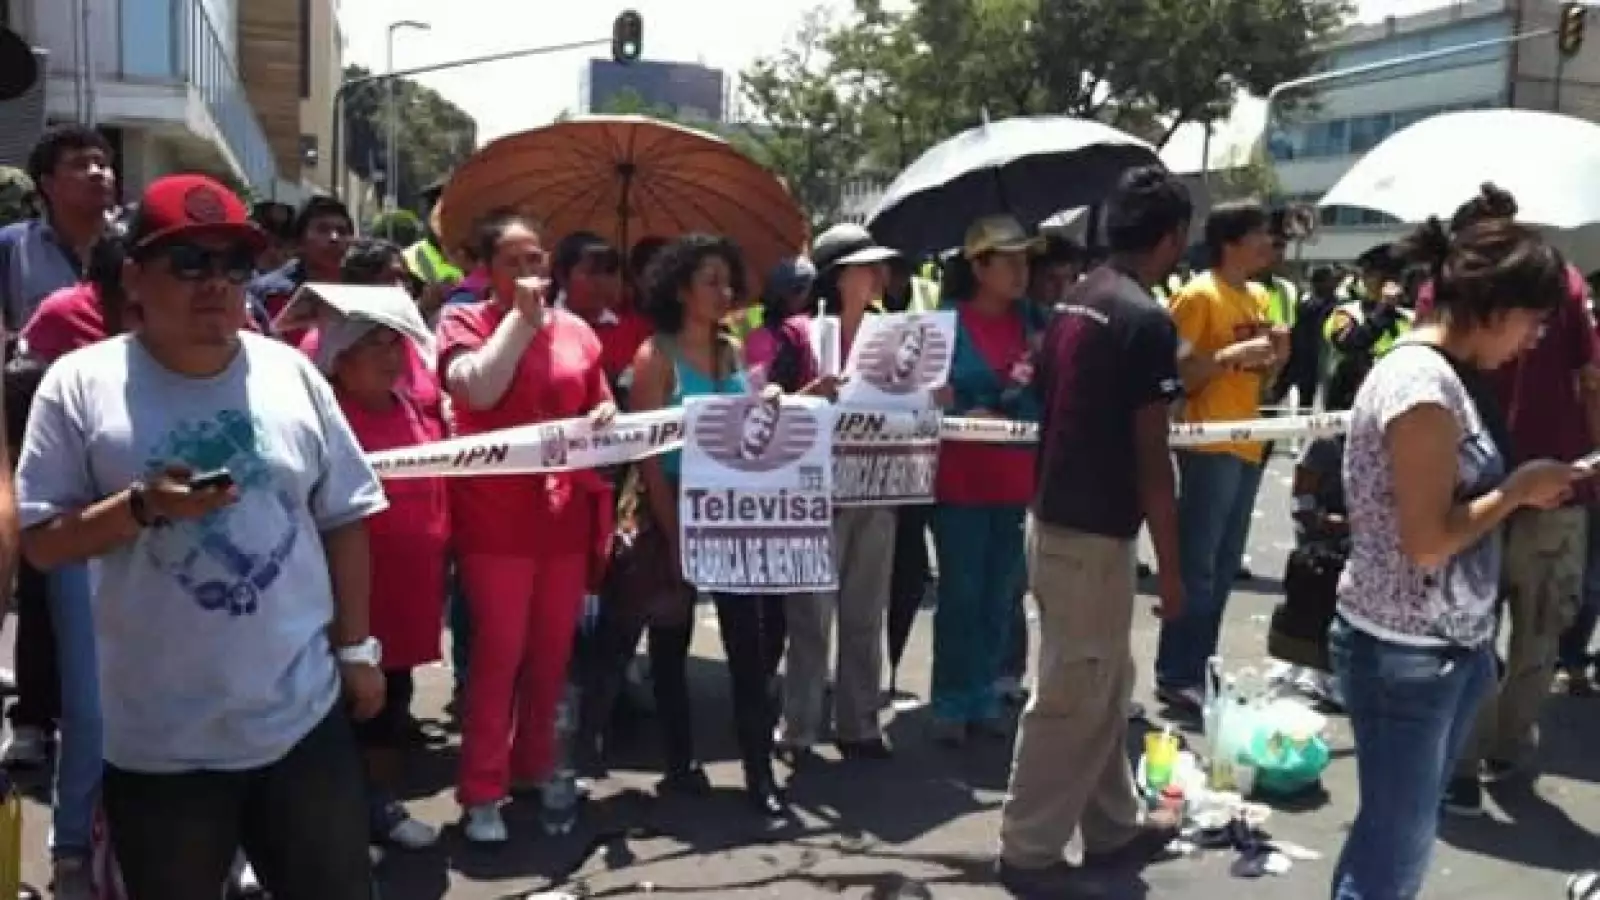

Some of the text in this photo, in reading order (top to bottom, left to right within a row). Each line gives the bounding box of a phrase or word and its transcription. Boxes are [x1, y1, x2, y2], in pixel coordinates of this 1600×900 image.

[835, 412, 886, 431] IPN
[452, 443, 508, 467] IPN
[685, 488, 828, 521] Televisa
